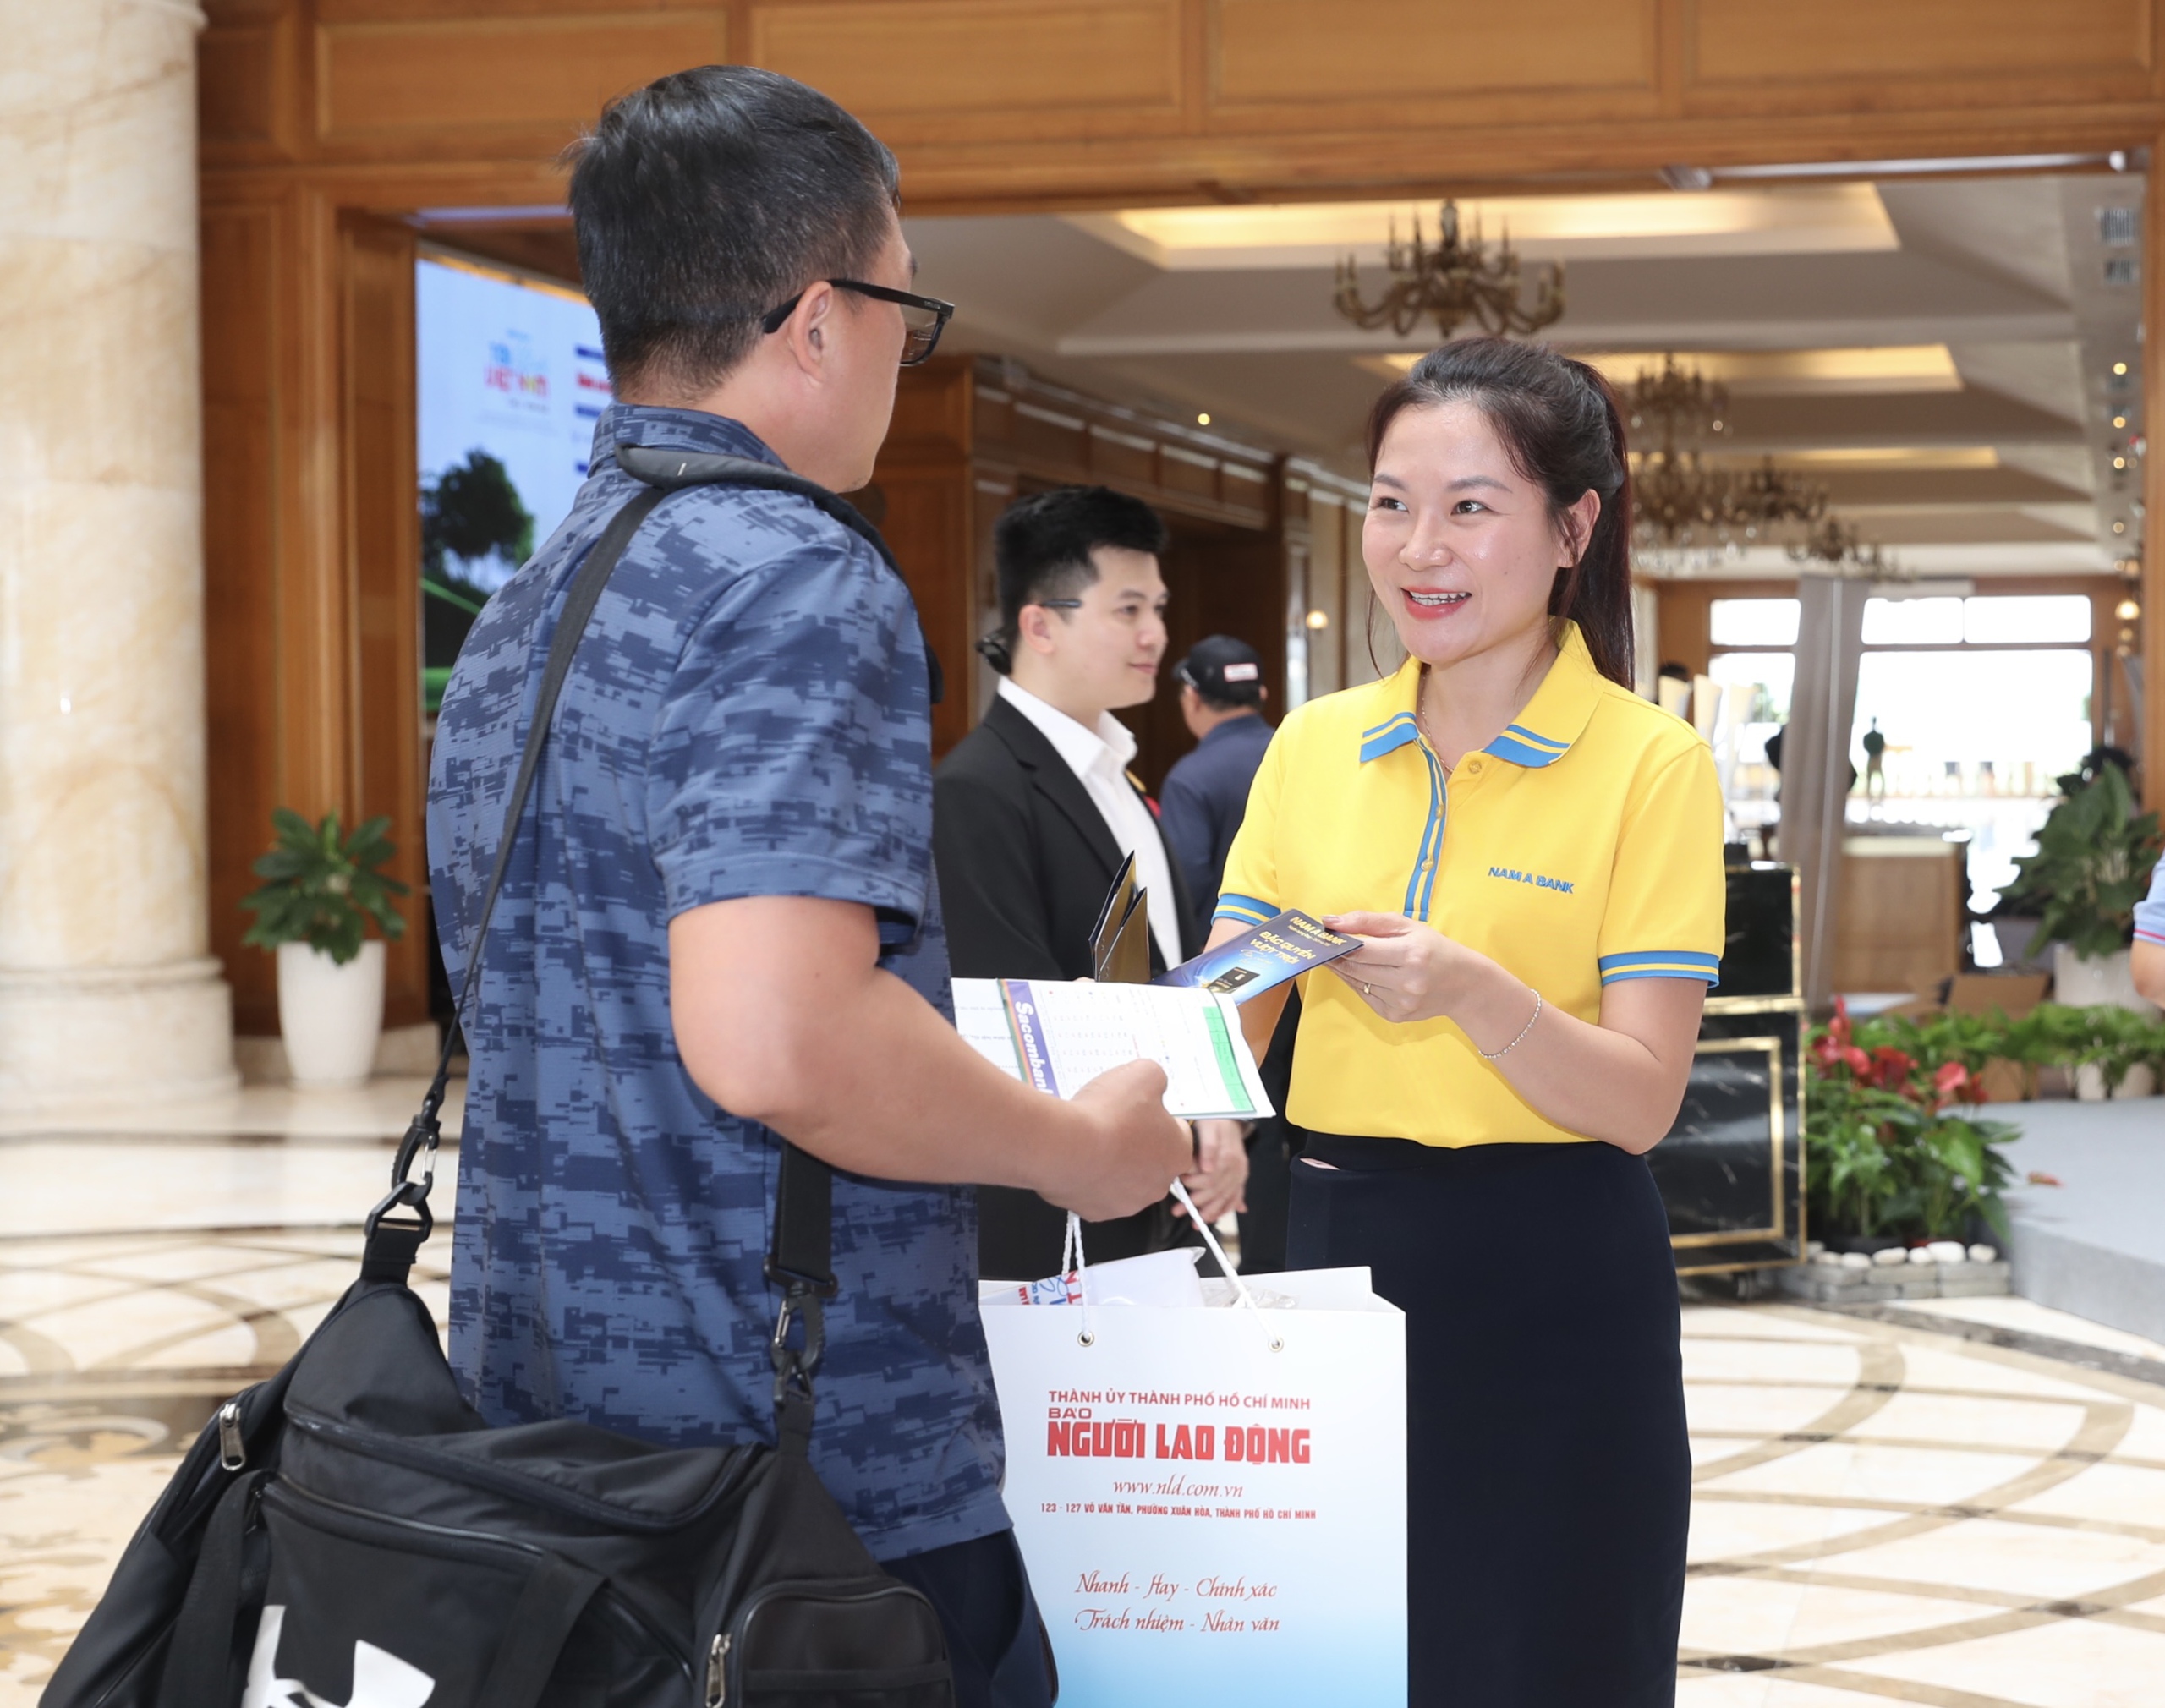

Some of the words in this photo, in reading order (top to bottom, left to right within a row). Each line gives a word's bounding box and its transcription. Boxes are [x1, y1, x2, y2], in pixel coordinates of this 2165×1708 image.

[1488, 867, 1522, 882] NAM
[1522, 873, 1533, 884] A
[1536, 875, 1575, 894] BANK
[1289, 917, 1316, 932] NAM
[1317, 931, 1347, 945] BANK
[1049, 1388, 1102, 1404] THÀNH
[1105, 1388, 1126, 1404] ỦY
[1129, 1390, 1181, 1405] THÀNH
[1184, 1390, 1215, 1407] PHỐ
[1243, 1394, 1268, 1409] CHÍ
[1271, 1397, 1310, 1410] MINH
[1048, 1407, 1093, 1419] BÁO
[1047, 1418, 1146, 1459] NGƯỜI
[1155, 1423, 1215, 1460] LAO
[1224, 1423, 1311, 1465] ĐỘNG
[1113, 1473, 1244, 1497] www.nld.com.vn
[1041, 1503, 1057, 1513] 123
[1066, 1503, 1082, 1513] 127
[1170, 1505, 1192, 1516] XUÂN
[1215, 1506, 1241, 1518] THÀNH
[1244, 1507, 1261, 1519] PHỐ
[1278, 1508, 1292, 1519] CHÍ
[1295, 1510, 1316, 1519] MINH
[1074, 1569, 1130, 1594] Nhanh
[1143, 1573, 1180, 1601] Hay
[1196, 1575, 1246, 1597] Chính
[1243, 1582, 1278, 1601] xác
[1074, 1607, 1131, 1631] Trách
[1135, 1607, 1185, 1633] nhiệm
[1200, 1609, 1245, 1632] Nhân
[1251, 1616, 1280, 1632] văn
